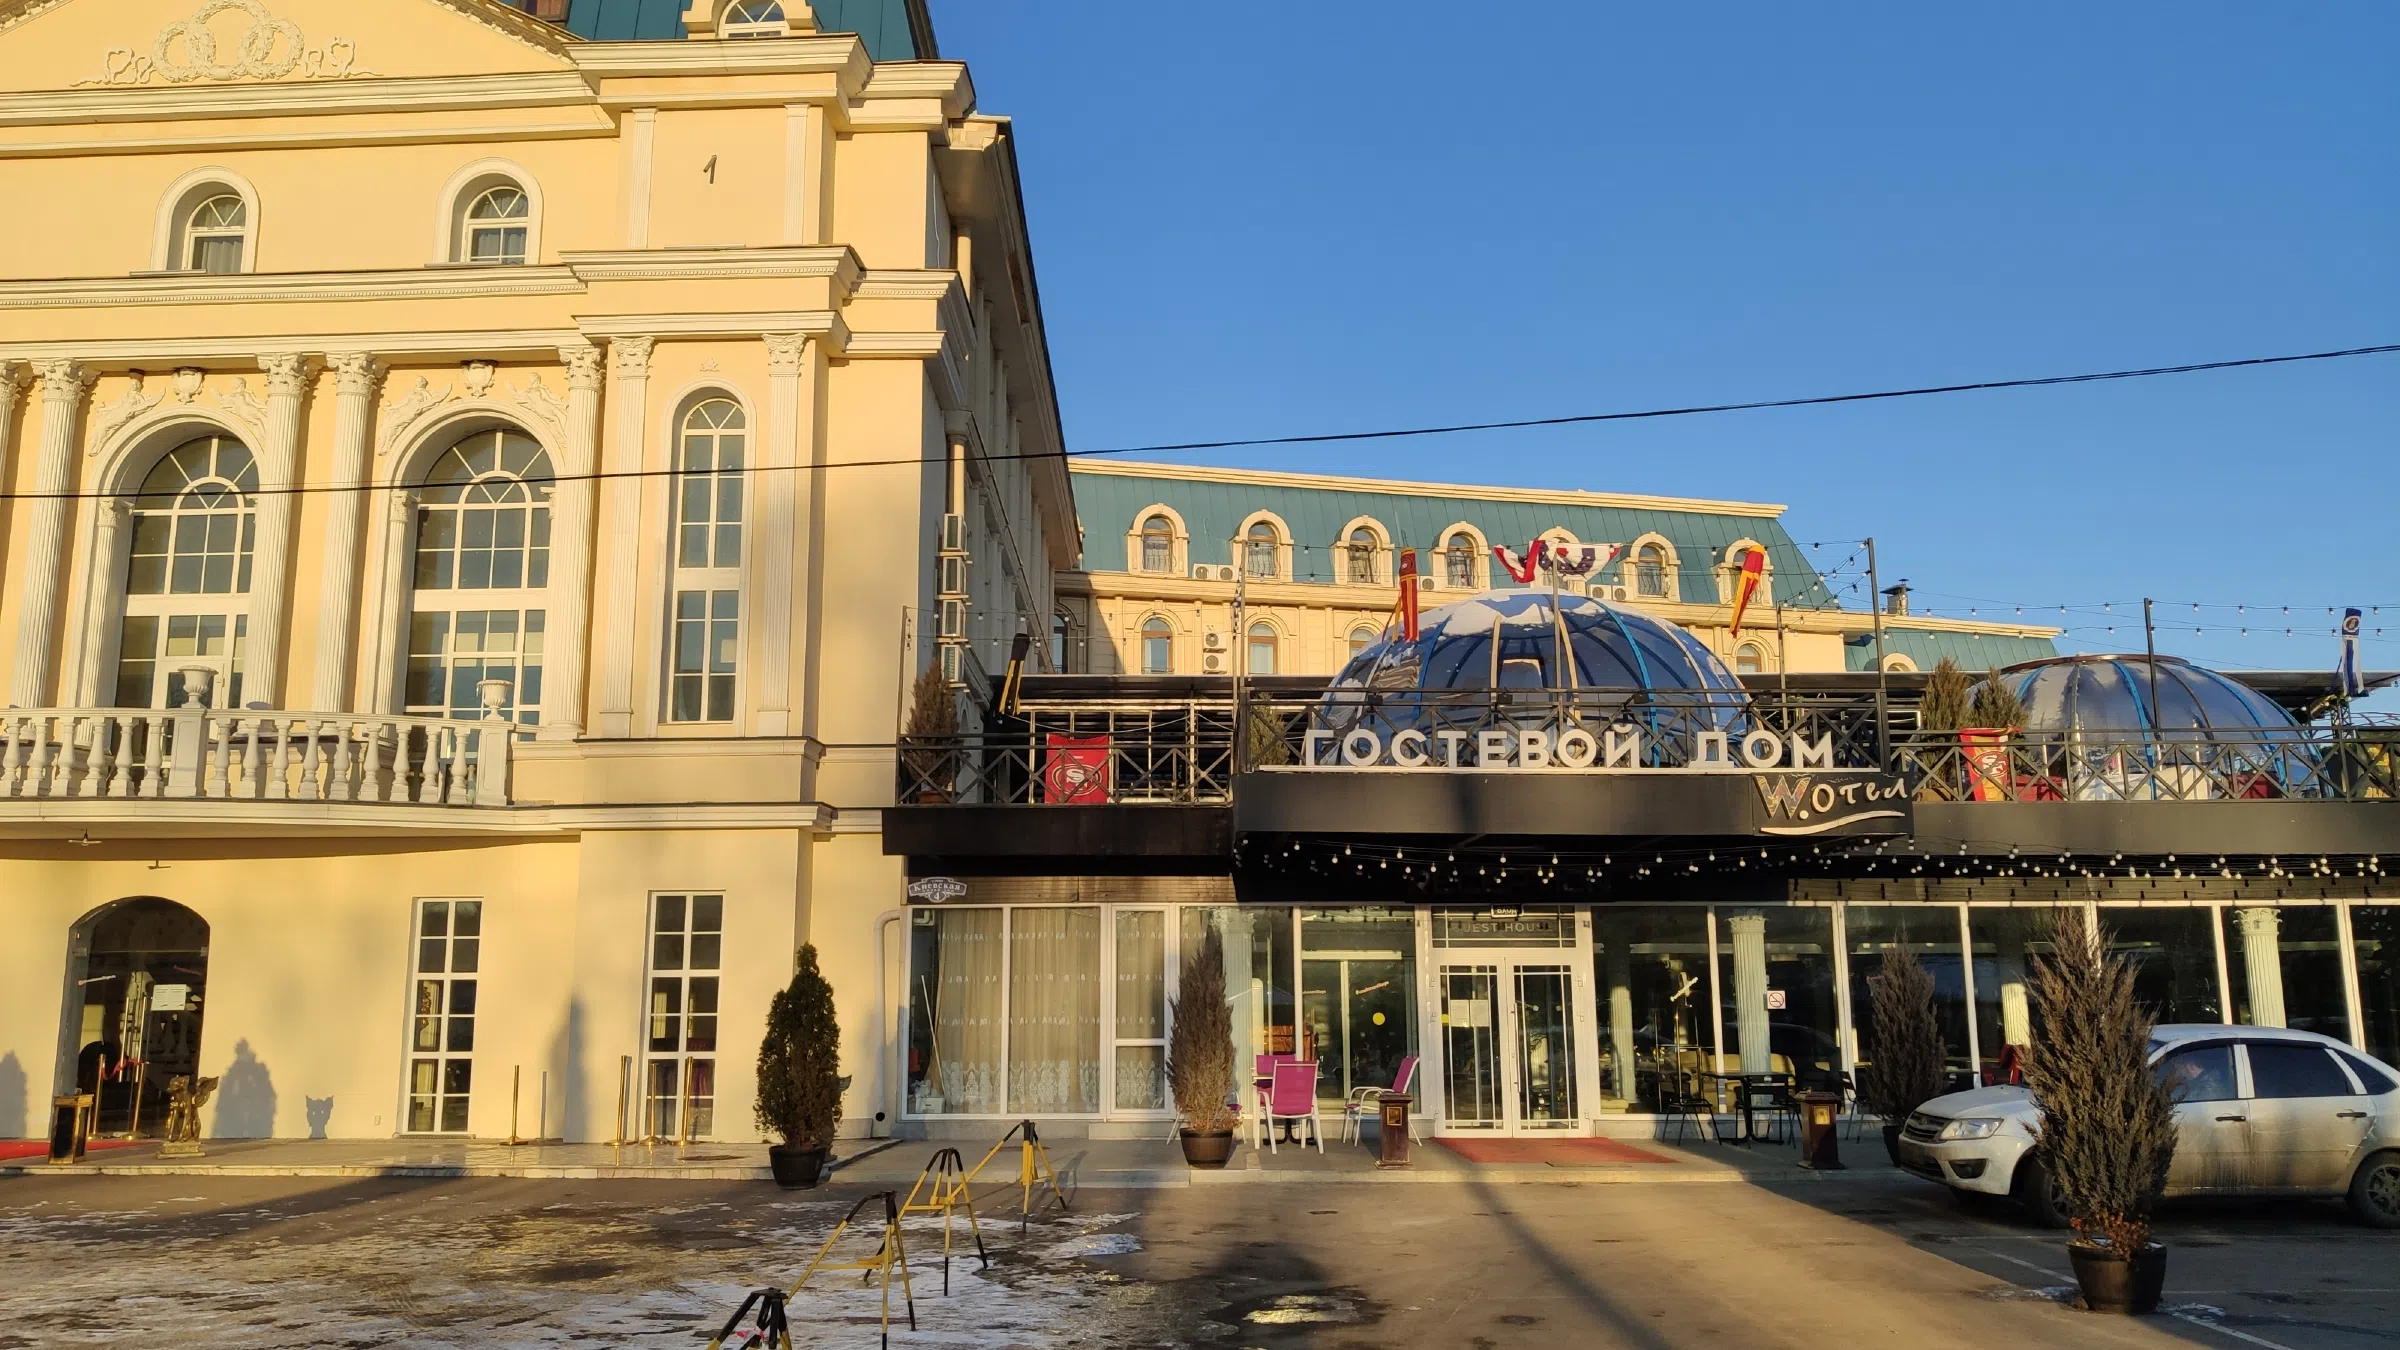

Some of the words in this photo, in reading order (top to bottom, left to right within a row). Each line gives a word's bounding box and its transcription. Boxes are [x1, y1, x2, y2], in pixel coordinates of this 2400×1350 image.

[1305, 723, 1641, 769] ГОСТЕВОЙ
[1688, 729, 1834, 769] ДОМ
[933, 892, 941, 901] 4
